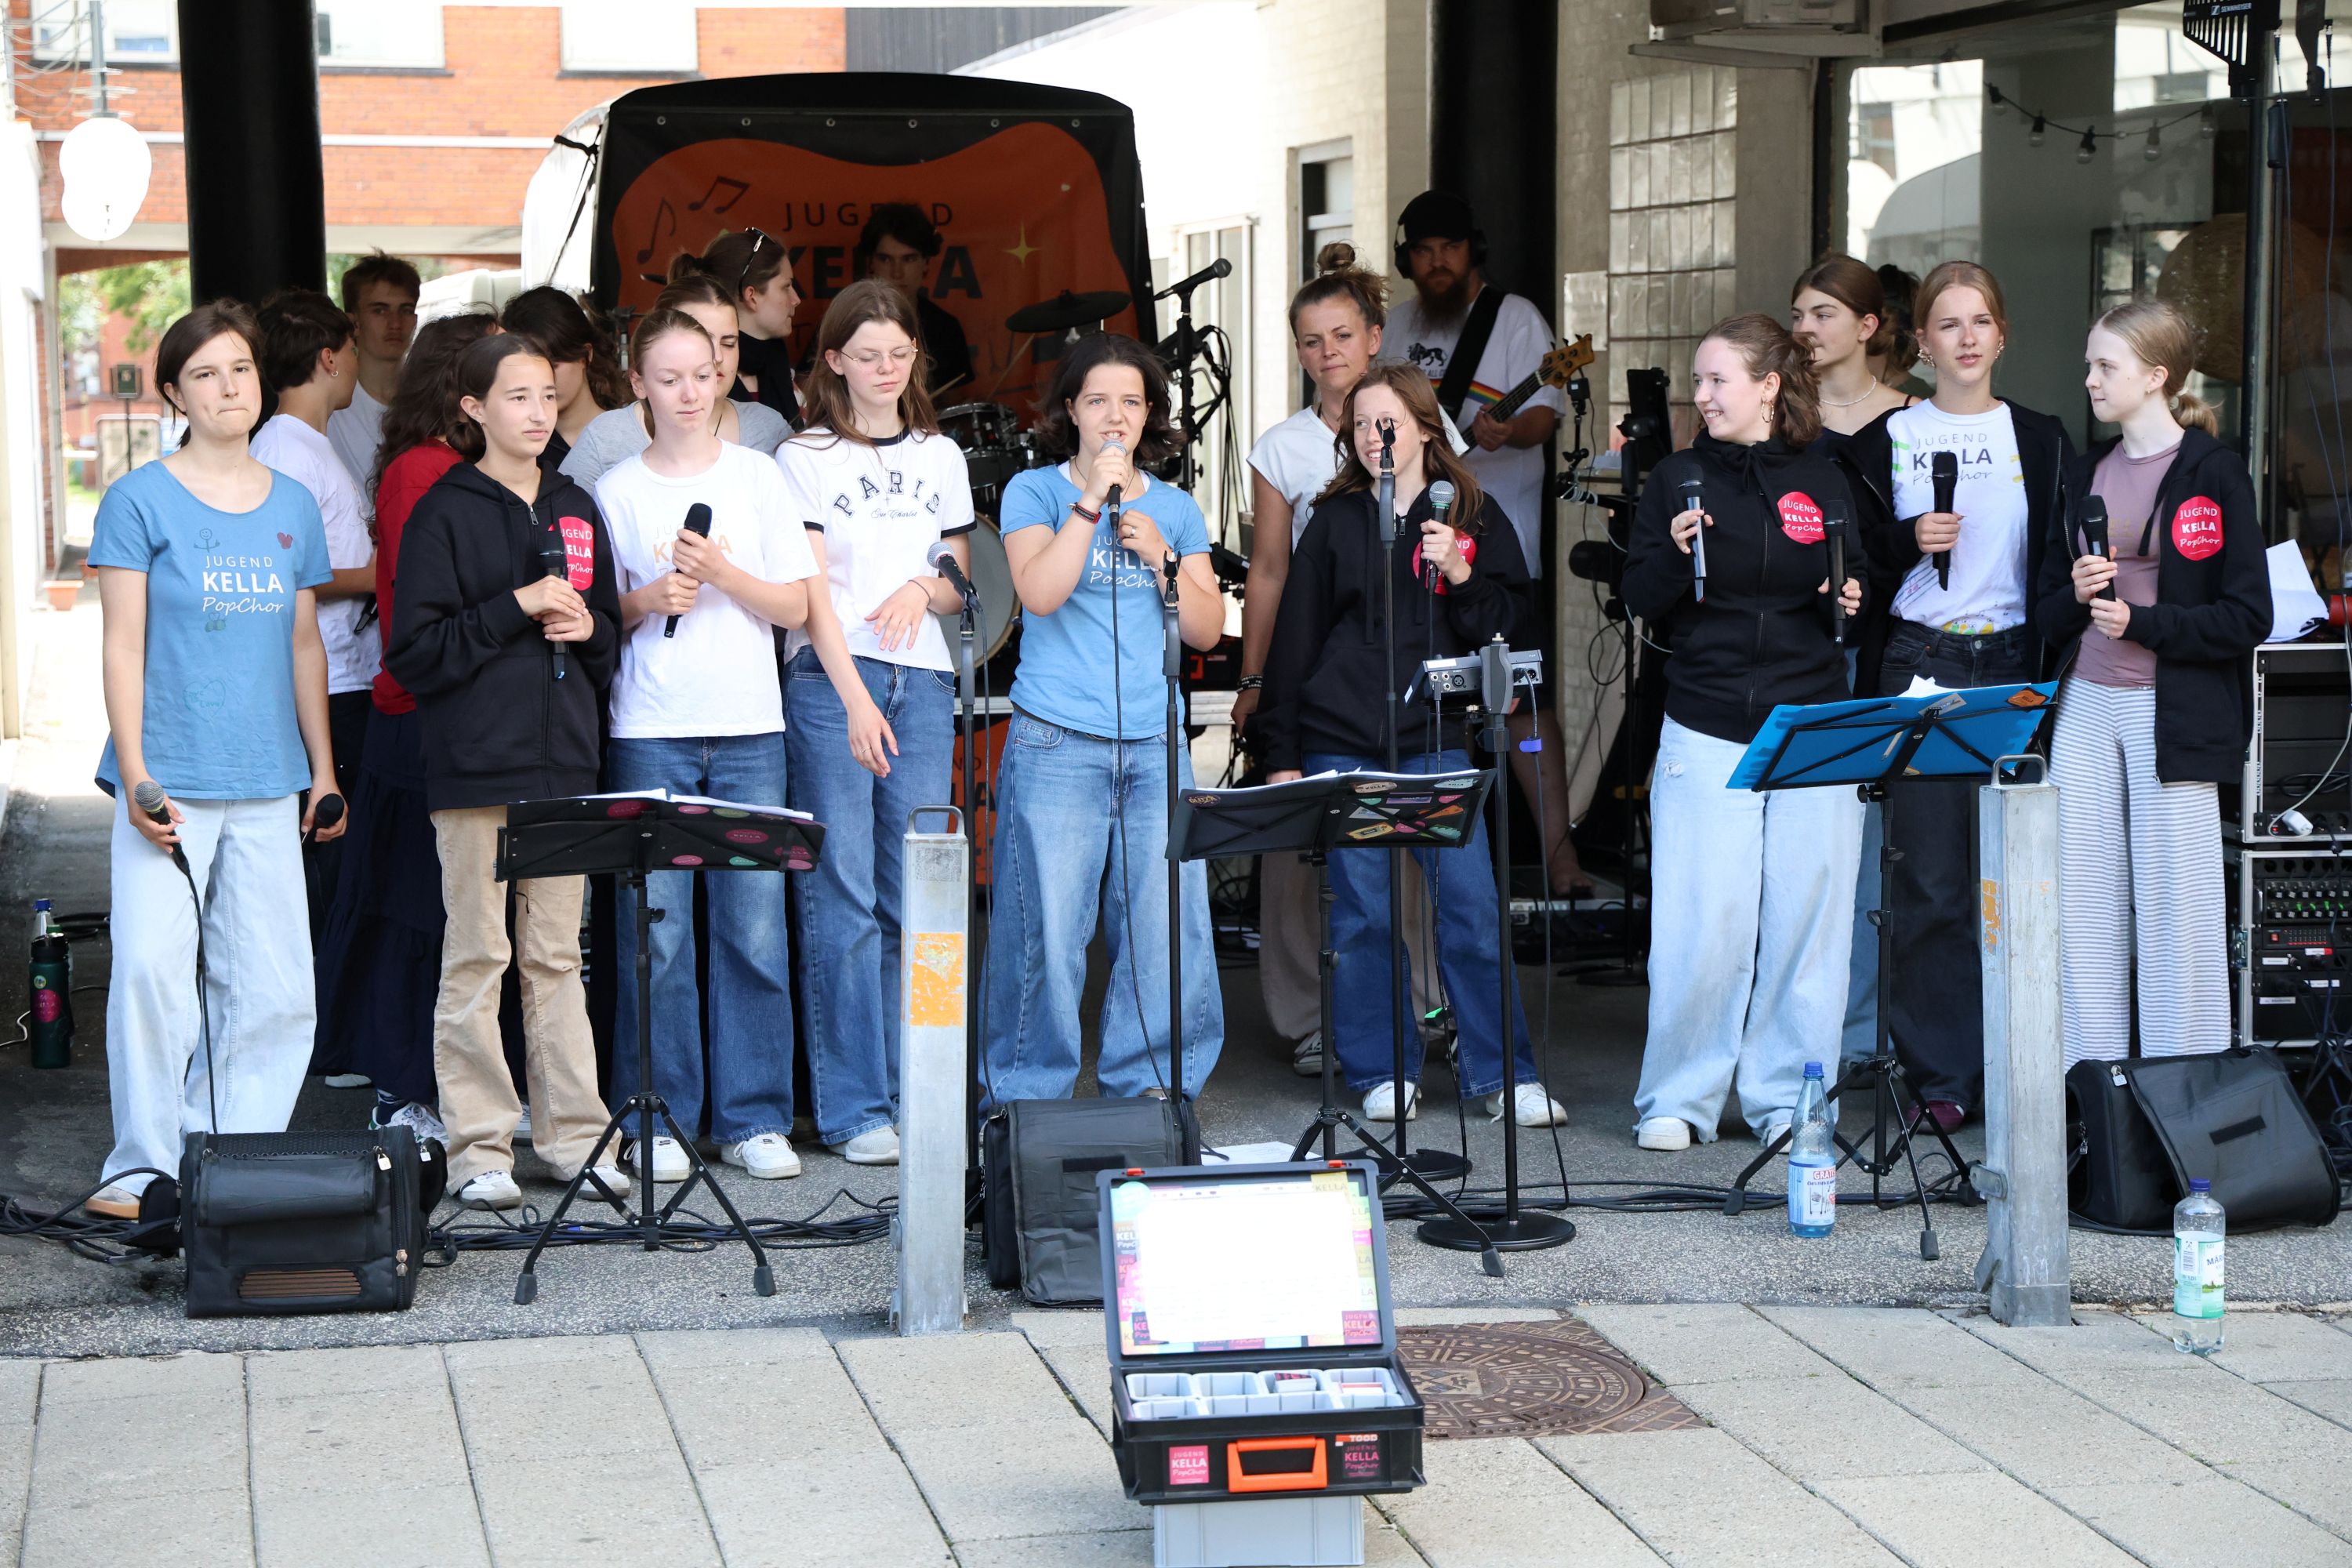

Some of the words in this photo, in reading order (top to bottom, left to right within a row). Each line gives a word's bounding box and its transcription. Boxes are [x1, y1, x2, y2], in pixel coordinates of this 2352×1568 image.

[2221, 3, 2252, 13] SENNHEISER
[782, 203, 953, 231] JUGD
[786, 245, 982, 299] KEA
[1916, 434, 1987, 449] JUGEND
[1913, 448, 1993, 470] KLA
[1913, 470, 1993, 485] Pohor
[833, 470, 939, 517] PARIS
[1784, 499, 1817, 514] JUGEND
[2180, 506, 2218, 520] JUGEND
[1784, 513, 1822, 523] KELLA
[562, 528, 593, 540] GEND
[653, 517, 721, 539] JUD
[1784, 523, 1824, 533] PopCho
[2182, 521, 2216, 534] KELLA
[1096, 535, 1123, 546] JUG
[2180, 535, 2220, 547] PopChor
[566, 544, 592, 559] ELLA
[205, 555, 274, 568] JUGEND
[1092, 548, 1151, 570] KELL
[568, 563, 593, 575] pChor
[202, 572, 285, 593] KELLA
[1090, 571, 1157, 589] PopCho
[202, 597, 284, 616] PopChor
[1116, 1232, 1136, 1241] KEL
[1344, 1319, 1377, 1328] KELLA
[1172, 1457, 1207, 1468] KELLA
[1345, 1451, 1380, 1461] KELLA
